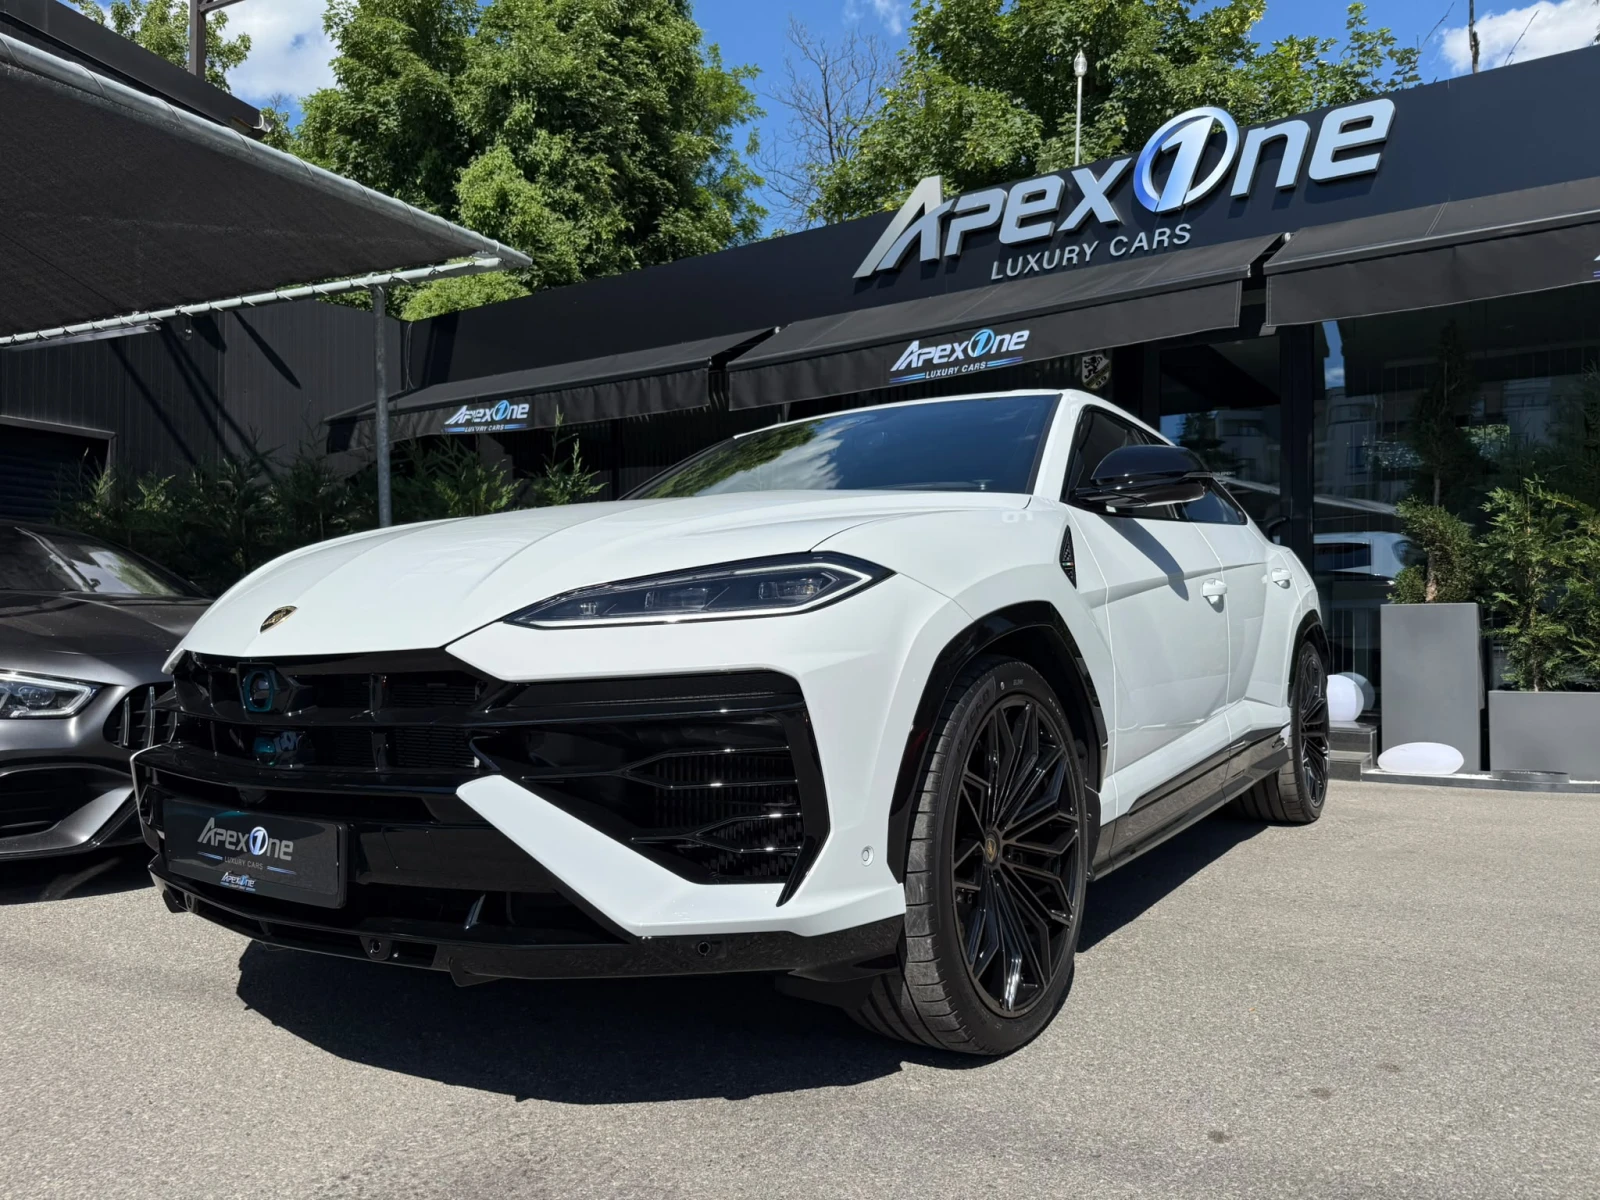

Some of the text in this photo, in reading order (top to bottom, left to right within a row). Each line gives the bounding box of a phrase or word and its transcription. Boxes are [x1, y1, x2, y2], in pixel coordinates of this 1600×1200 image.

[990, 222, 1193, 281] LUXURY CARS
[925, 361, 987, 379] LUXURY CARS
[464, 424, 505, 433] LUXURY CARS
[224, 855, 264, 871] LUXURY CARS
